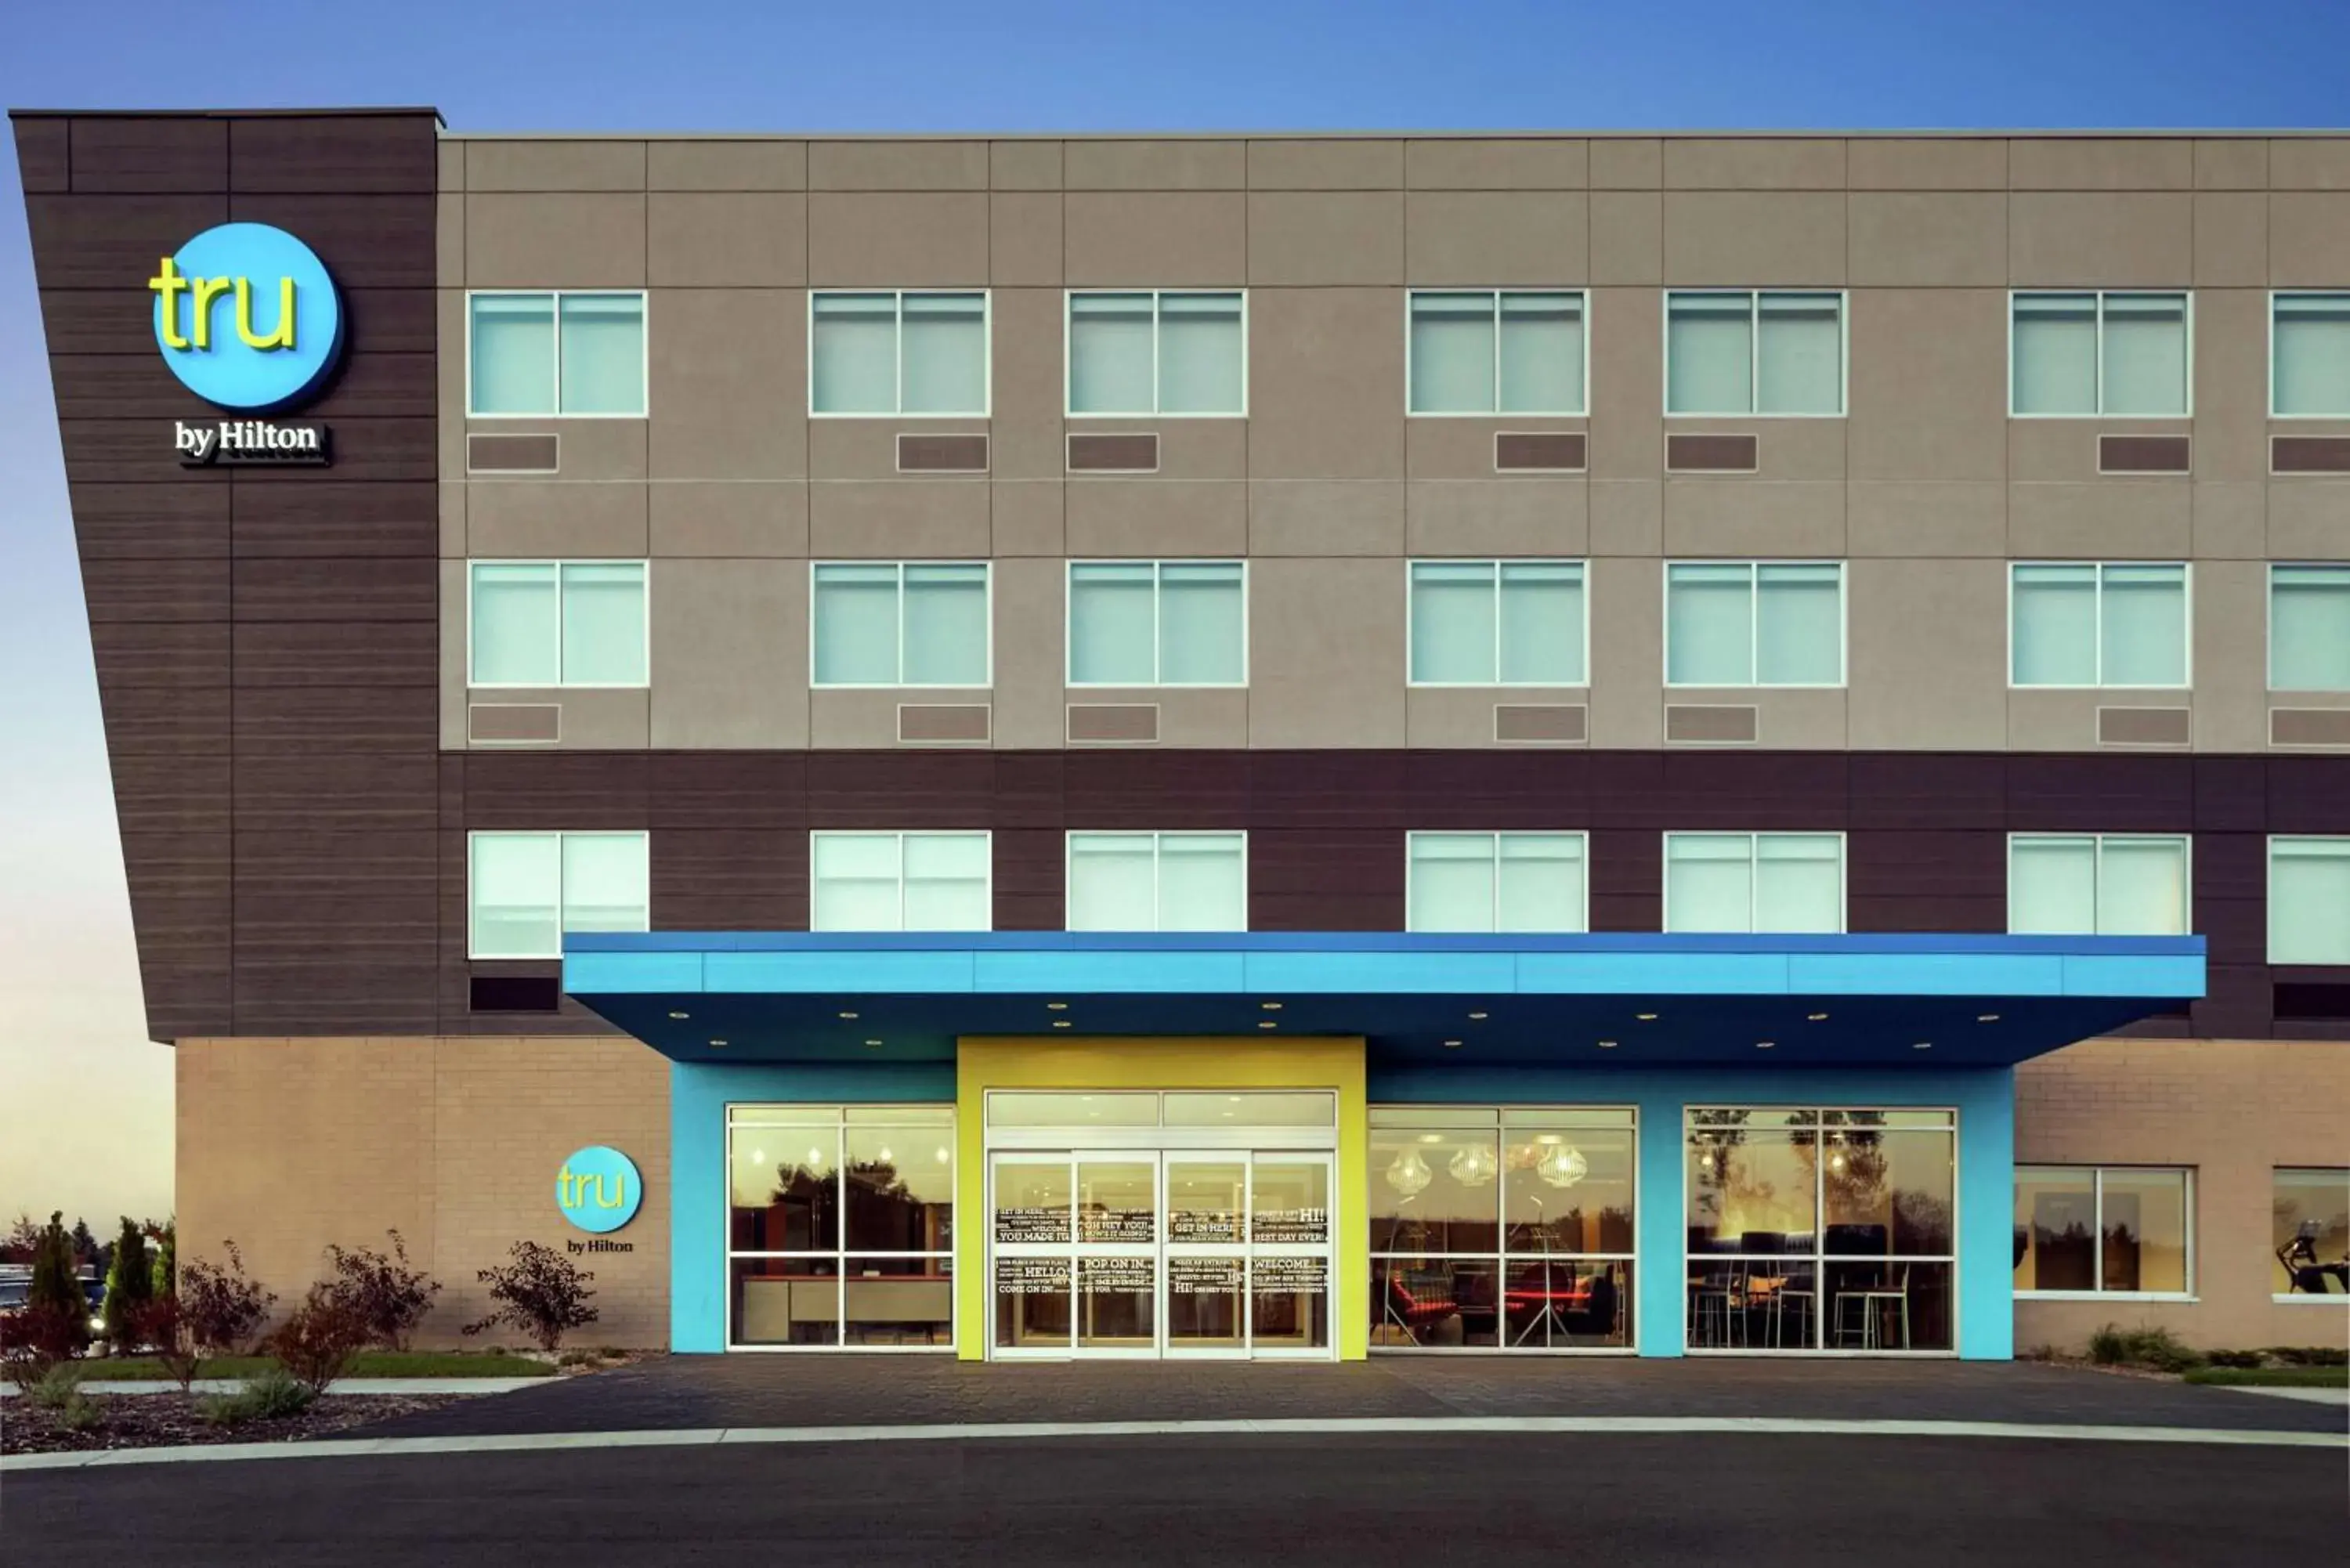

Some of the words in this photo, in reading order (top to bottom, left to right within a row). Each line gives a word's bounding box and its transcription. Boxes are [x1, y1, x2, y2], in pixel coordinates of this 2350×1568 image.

[149, 257, 295, 349] tru
[175, 421, 213, 457] by
[219, 421, 317, 450] Hilton
[558, 1164, 624, 1209] tru
[1000, 1232, 1021, 1241] YOU
[1024, 1232, 1054, 1241] MADE
[1278, 1233, 1296, 1241] DAY
[567, 1239, 584, 1256] by
[588, 1239, 633, 1252] Hilton
[1085, 1259, 1108, 1269] POP
[1110, 1259, 1129, 1269] ON
